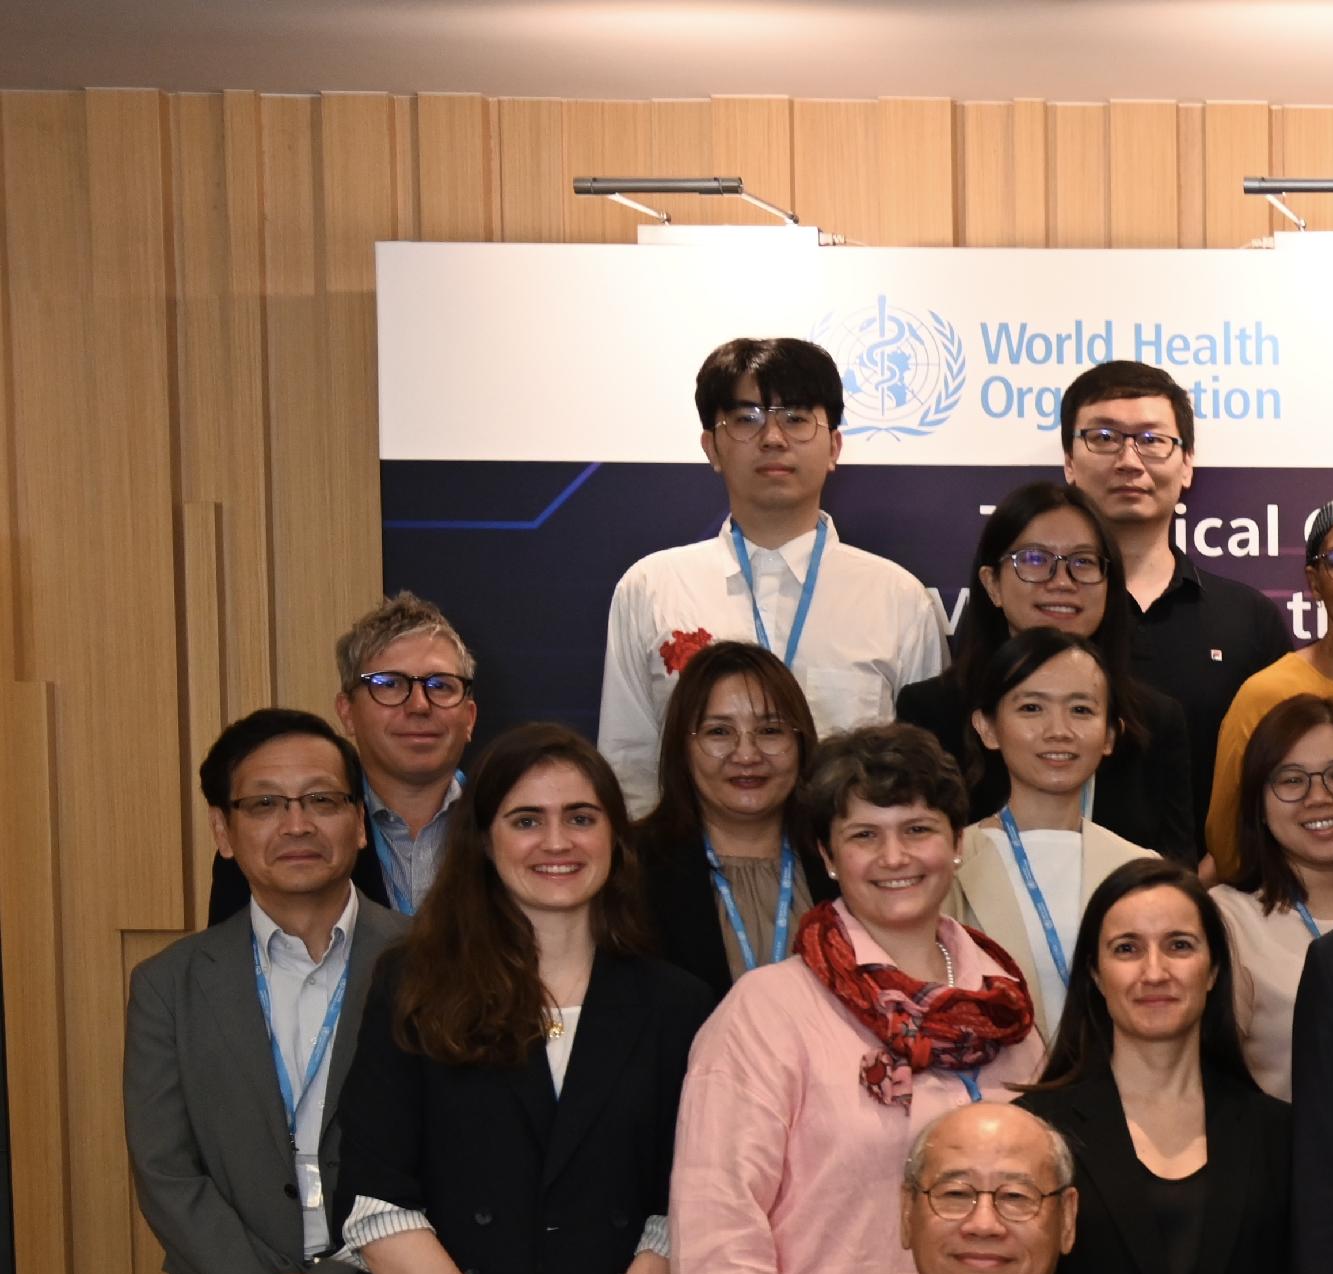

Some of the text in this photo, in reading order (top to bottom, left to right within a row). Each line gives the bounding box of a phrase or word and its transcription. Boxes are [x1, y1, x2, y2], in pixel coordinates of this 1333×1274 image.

[980, 319, 1281, 366] World Health
[980, 375, 1281, 431] Orgtion
